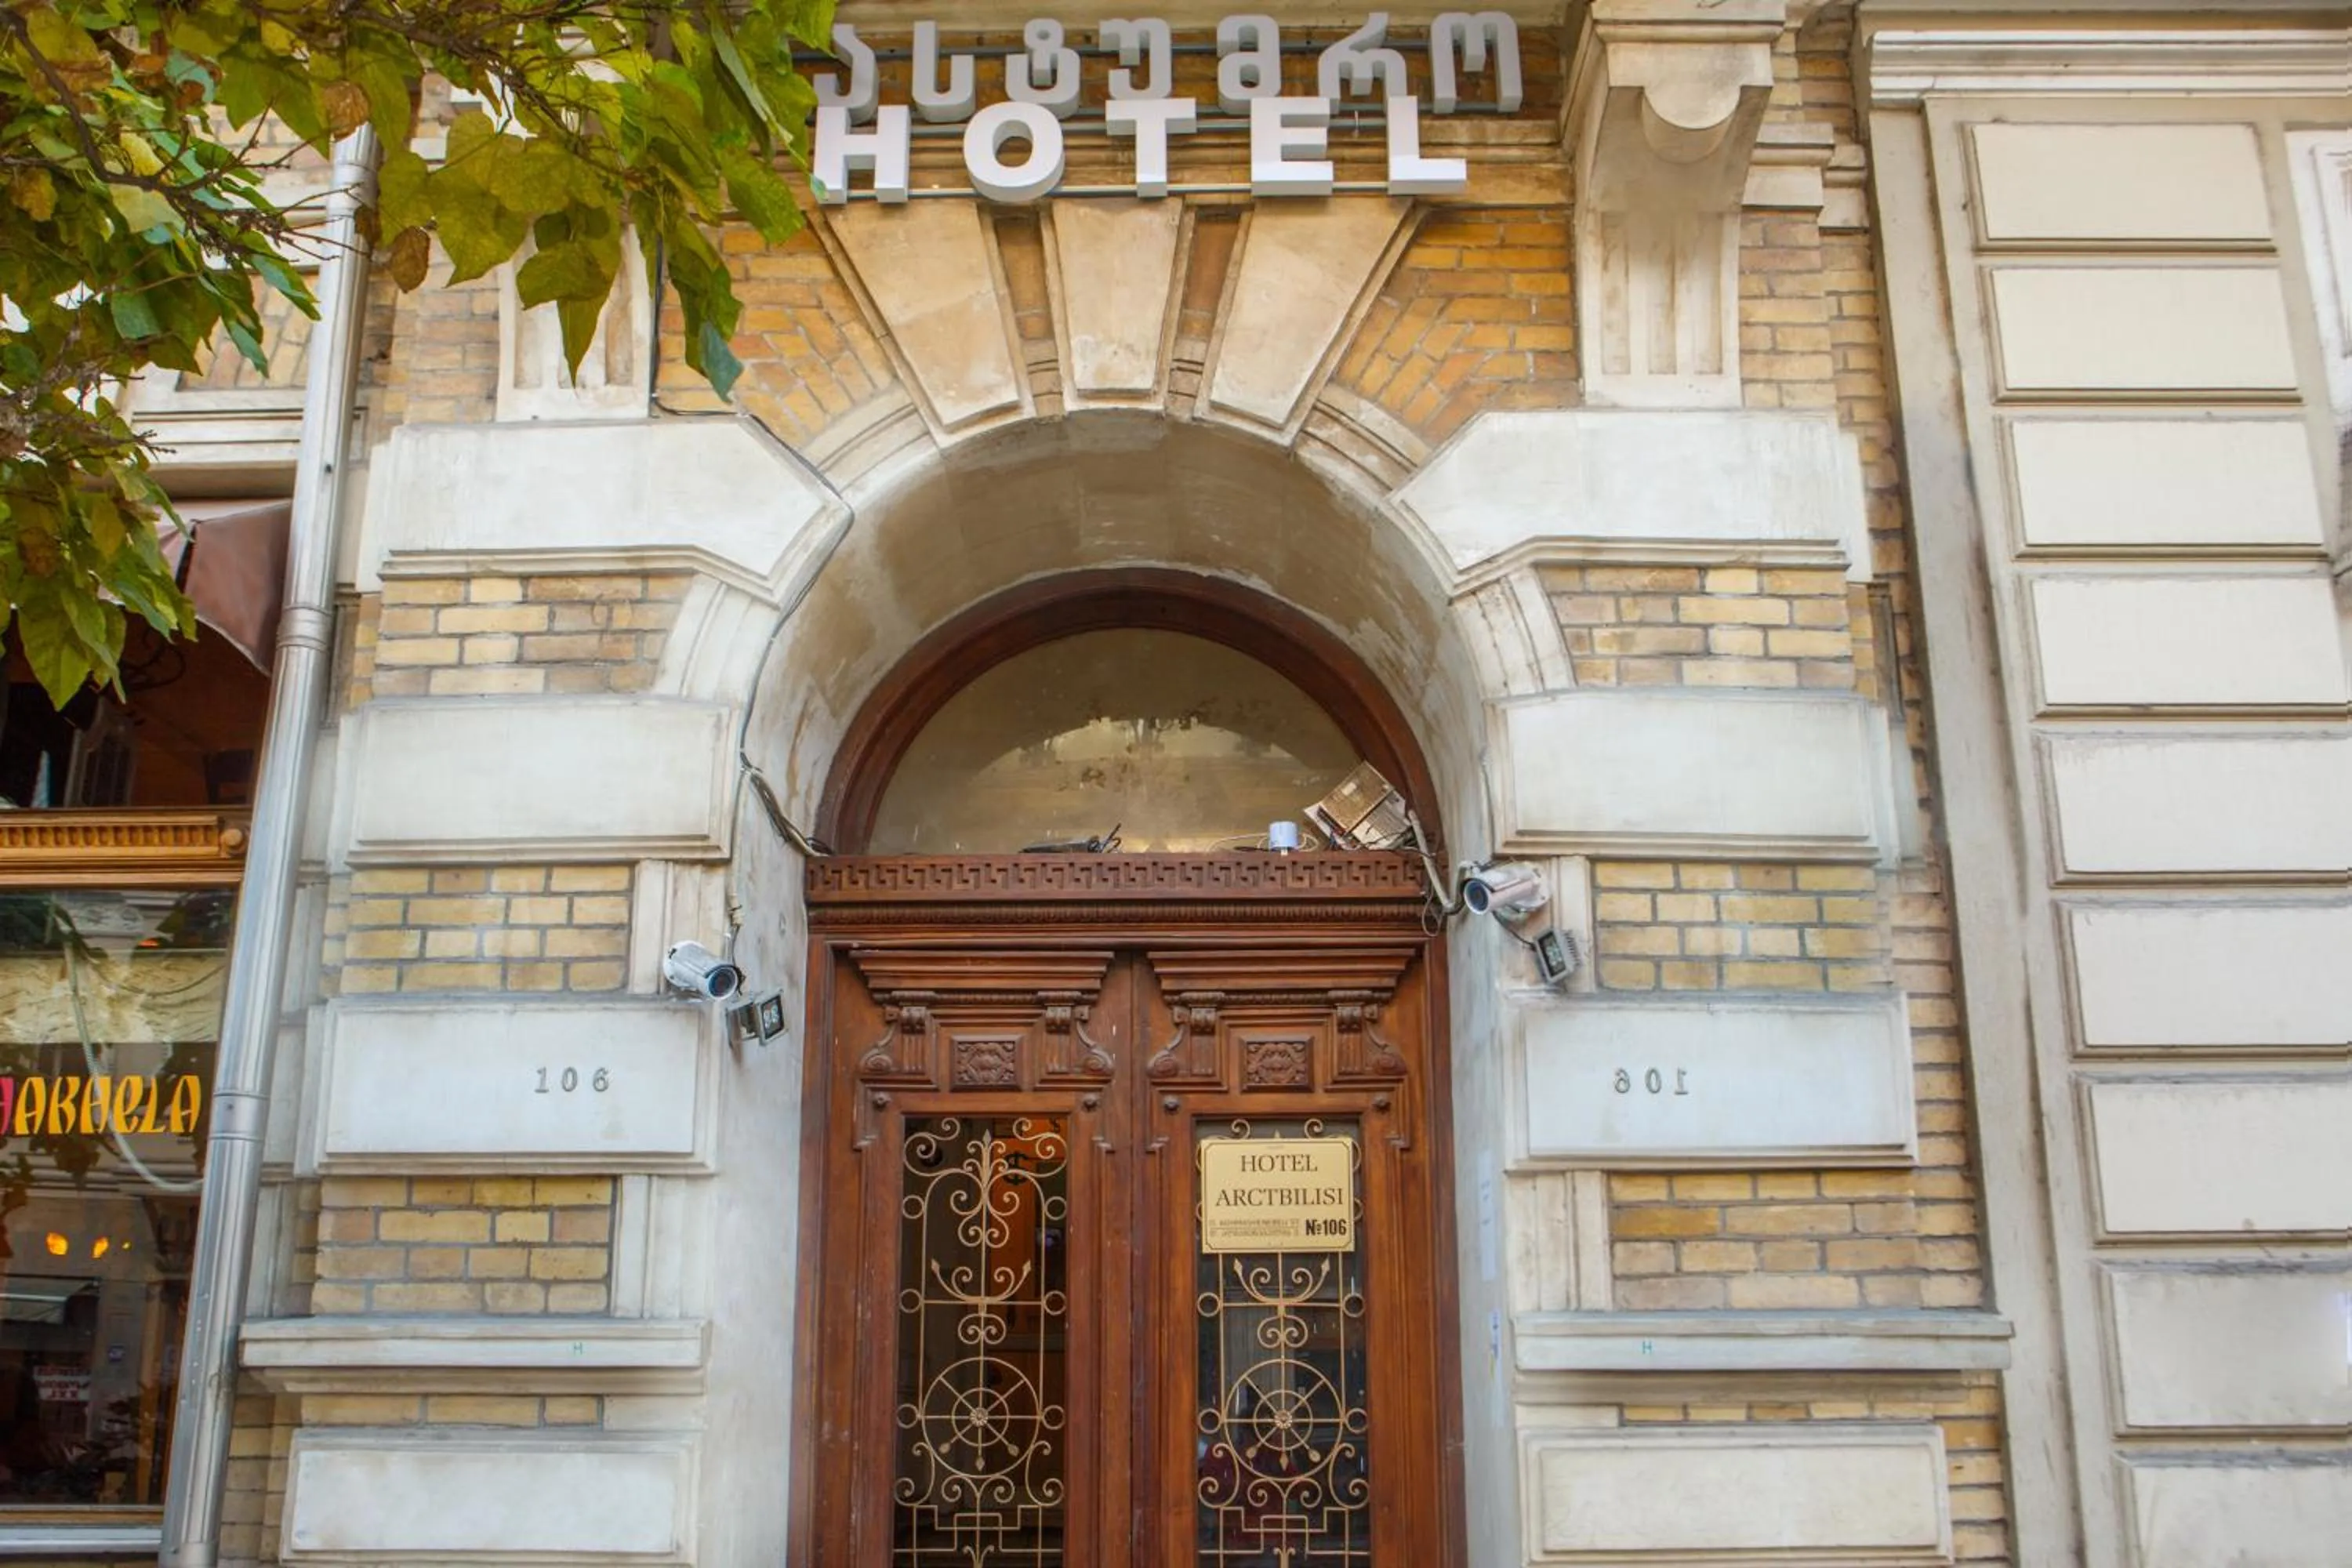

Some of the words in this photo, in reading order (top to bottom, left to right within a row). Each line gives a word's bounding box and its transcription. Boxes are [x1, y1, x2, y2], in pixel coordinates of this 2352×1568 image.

[813, 11, 1523, 125] ასტუმრო
[813, 96, 1467, 204] HOTEL
[534, 1066, 610, 1094] 106
[1240, 1154, 1318, 1173] HOTEL
[1215, 1188, 1344, 1207] ARCTBILISI
